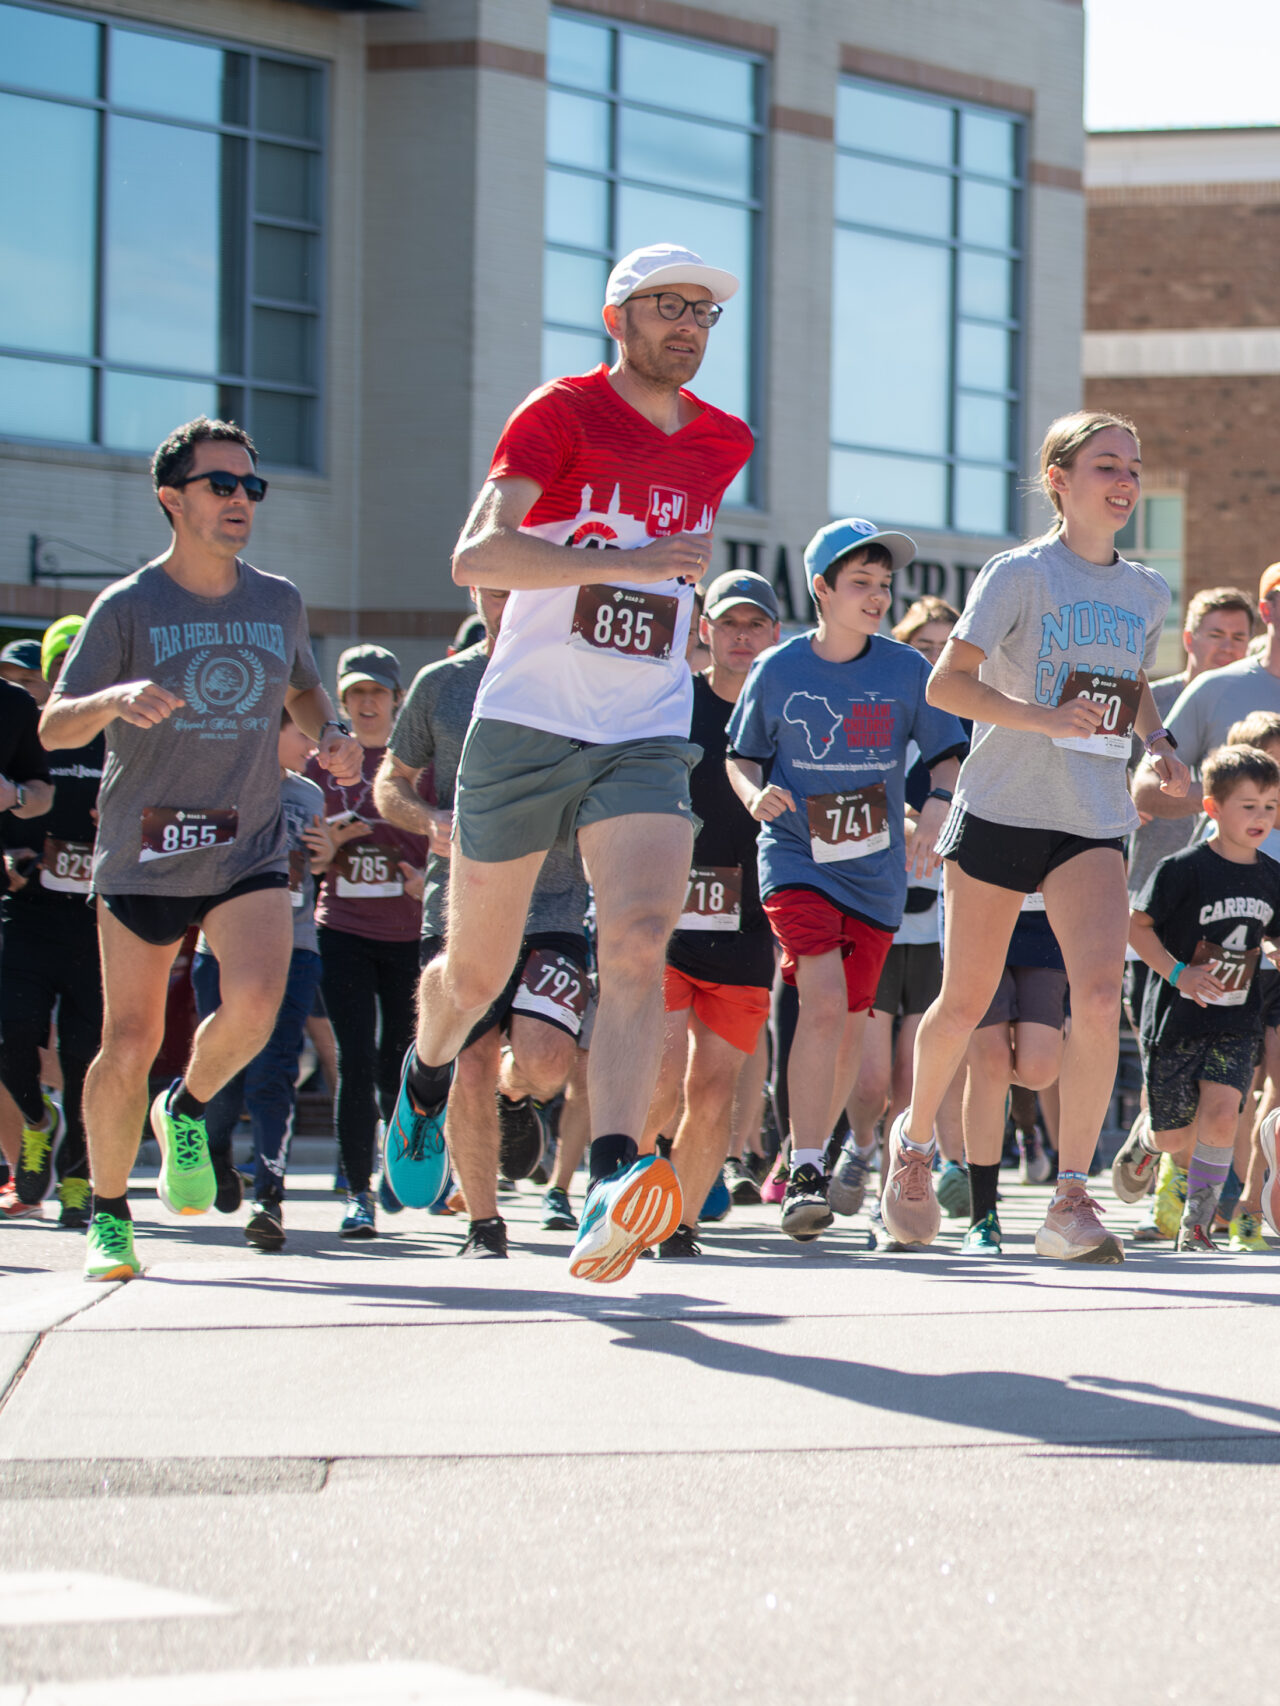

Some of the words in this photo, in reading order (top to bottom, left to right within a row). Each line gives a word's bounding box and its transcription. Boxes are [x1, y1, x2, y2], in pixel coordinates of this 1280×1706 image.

[651, 491, 683, 528] LSV
[150, 623, 184, 667] TAR
[183, 622, 224, 650] HEEL
[225, 621, 245, 645] 10
[245, 621, 287, 664] MILER
[594, 604, 654, 651] 835
[162, 824, 217, 851] 855
[826, 803, 872, 840] 741
[348, 856, 388, 882] 785
[1221, 924, 1248, 951] 4
[534, 964, 580, 1008] 792
